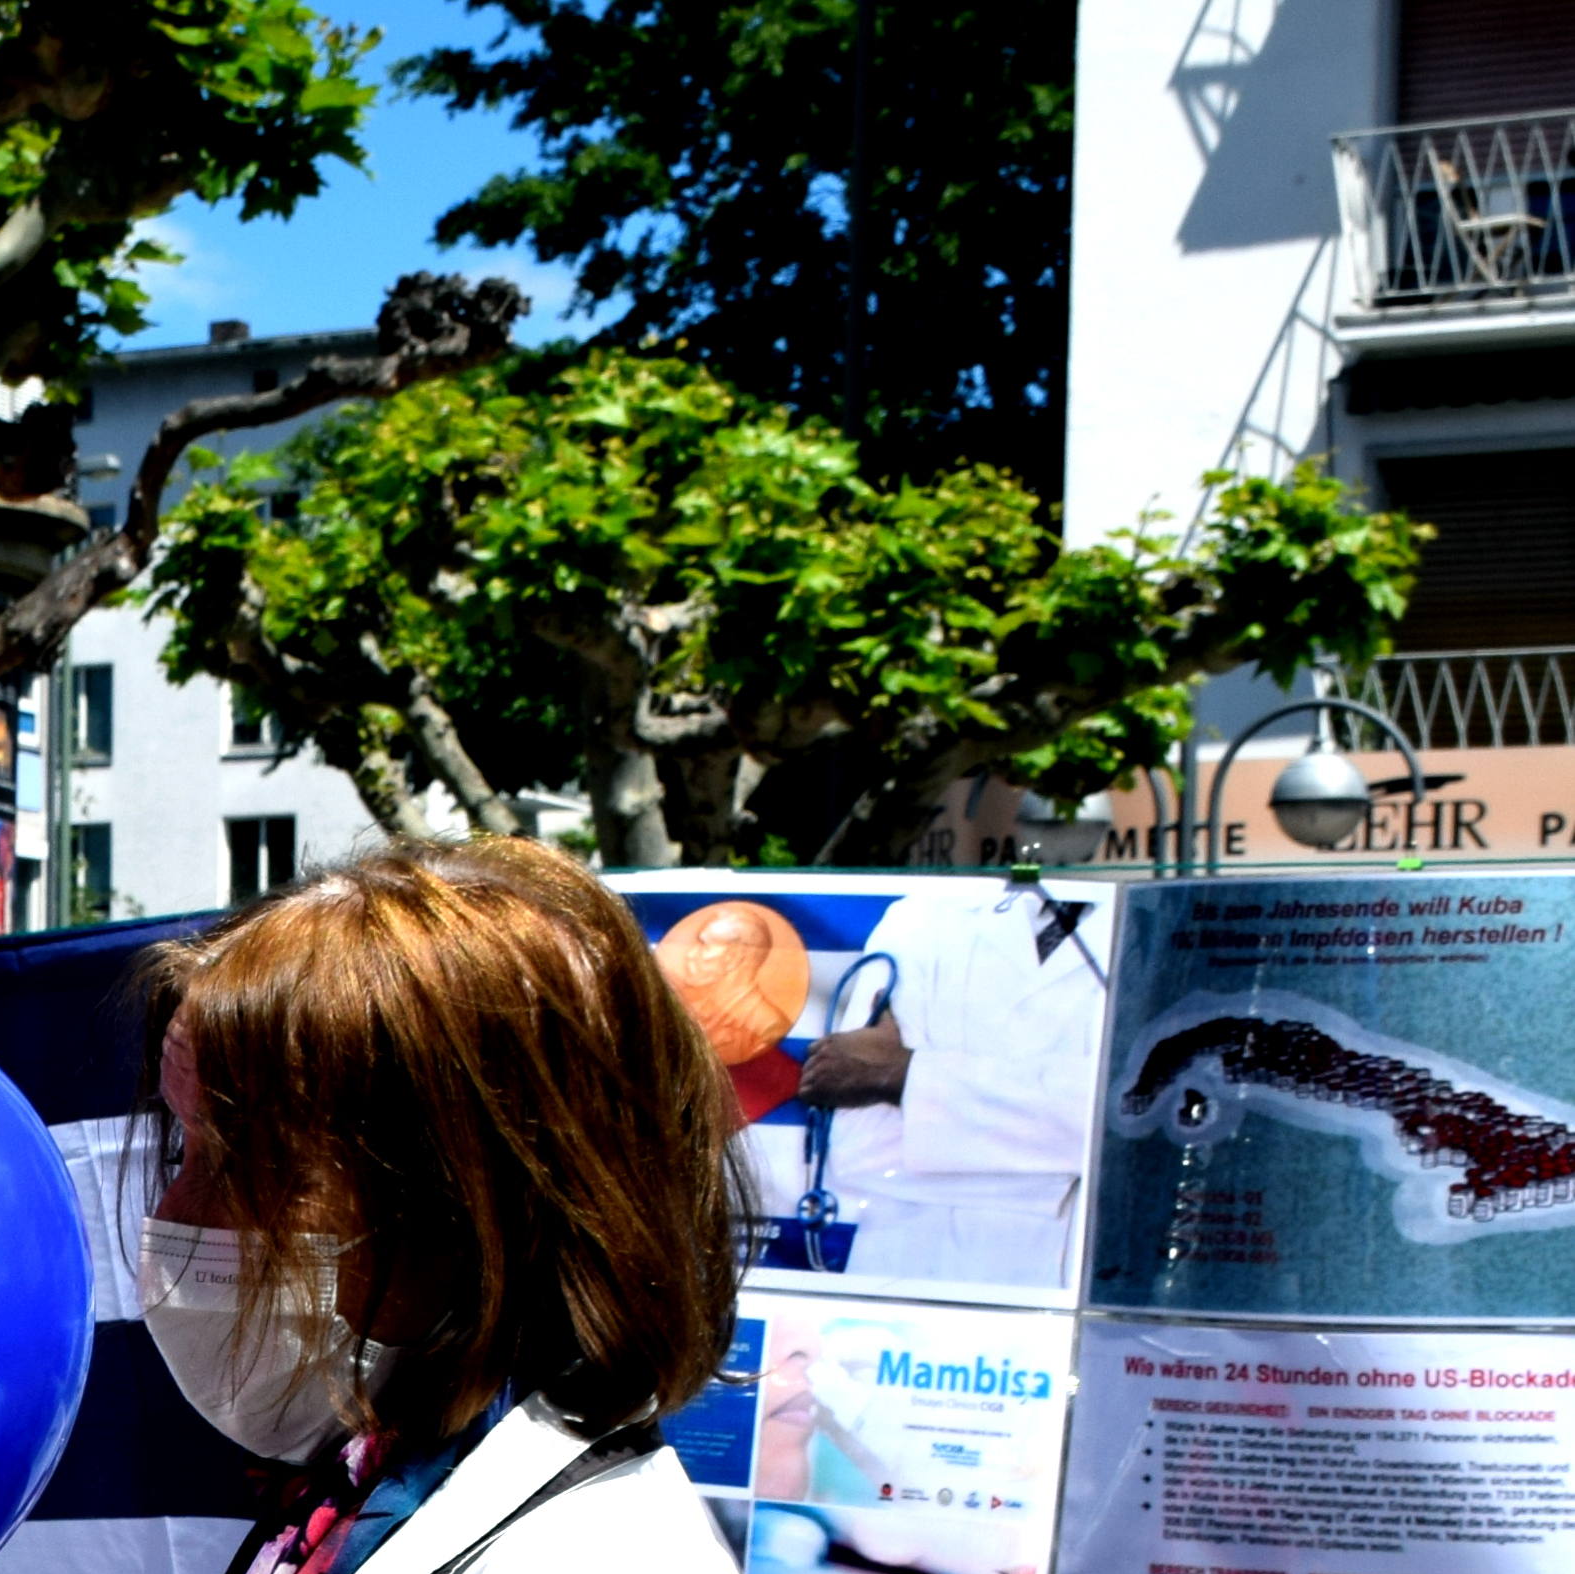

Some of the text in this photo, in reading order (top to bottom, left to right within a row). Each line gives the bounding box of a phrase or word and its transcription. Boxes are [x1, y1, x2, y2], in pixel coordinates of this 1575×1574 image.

[1267, 898, 1400, 920] Jahresende
[1408, 896, 1450, 916] will
[1456, 894, 1524, 916] Kuba
[1289, 925, 1413, 952] Impfdosen
[1421, 924, 1546, 946] herstellen
[876, 1350, 1051, 1400] Mambisa
[1224, 1362, 1249, 1381] 24
[1255, 1363, 1349, 1387] Stunden
[1356, 1367, 1415, 1388] ohne
